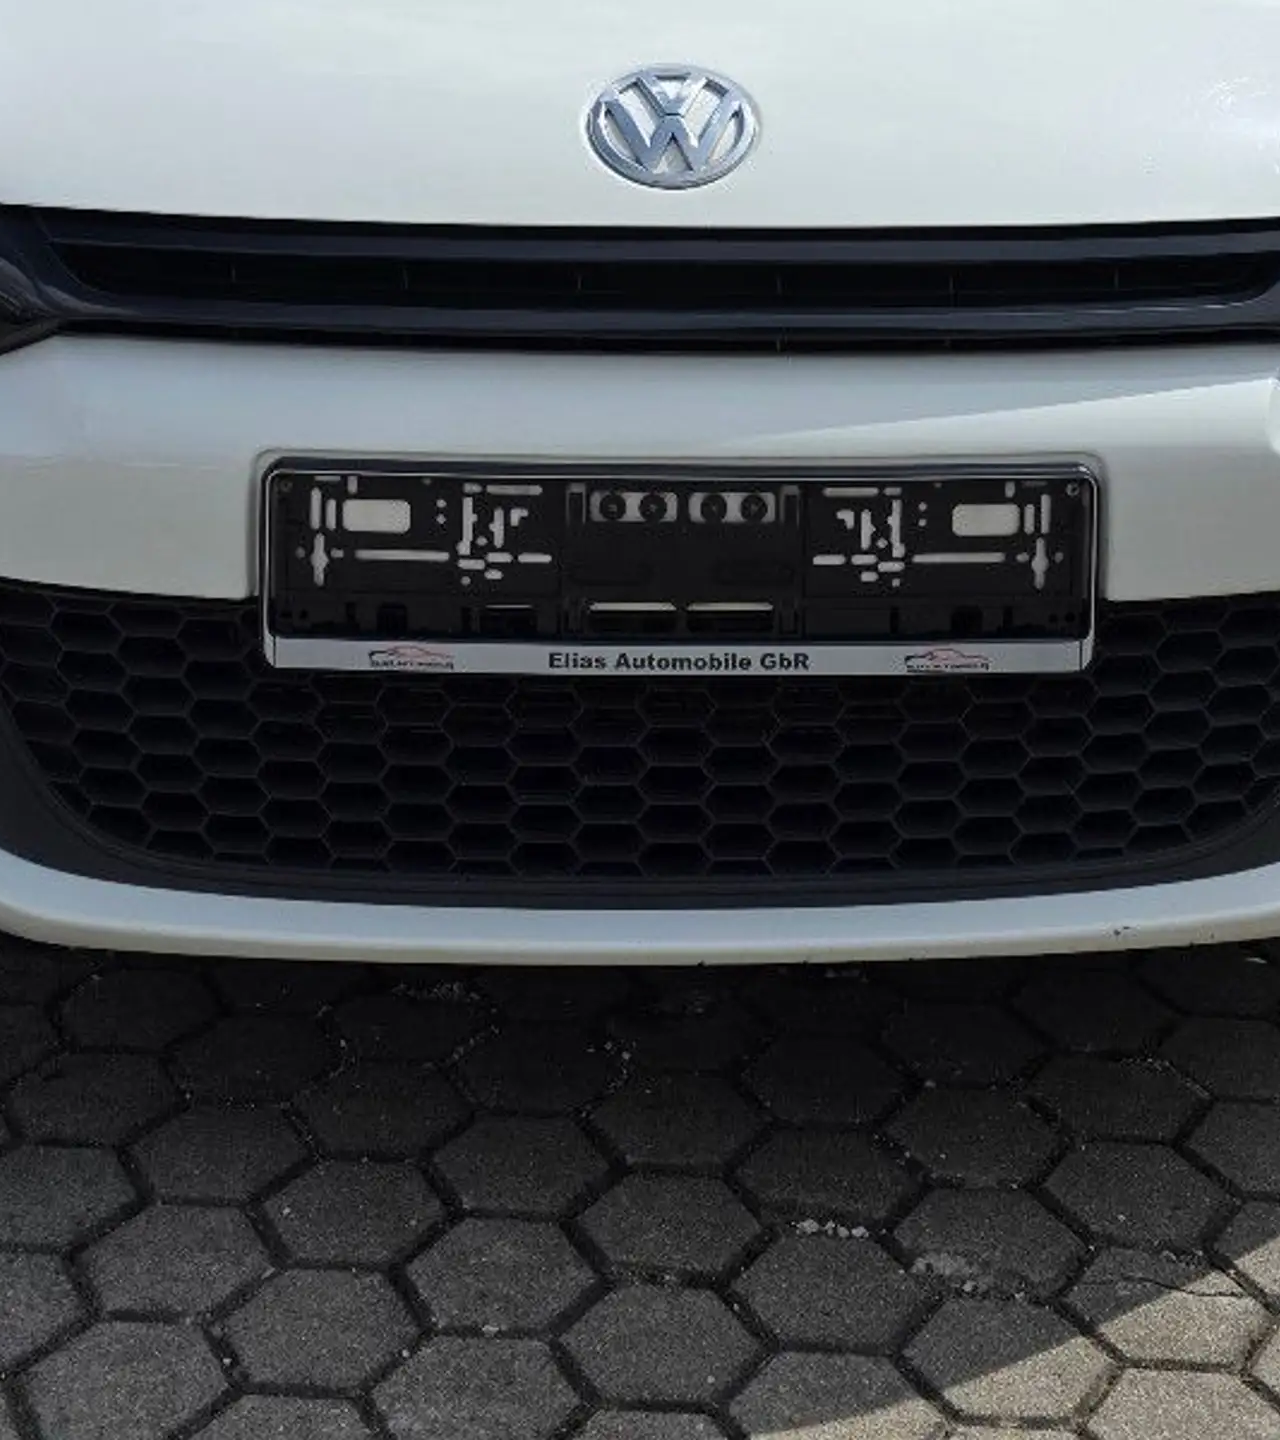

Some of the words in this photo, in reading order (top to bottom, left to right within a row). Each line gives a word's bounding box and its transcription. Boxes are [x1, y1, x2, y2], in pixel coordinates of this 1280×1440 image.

[548, 651, 607, 671] Elias
[615, 651, 752, 672] Automobile
[759, 651, 811, 672] GbR
